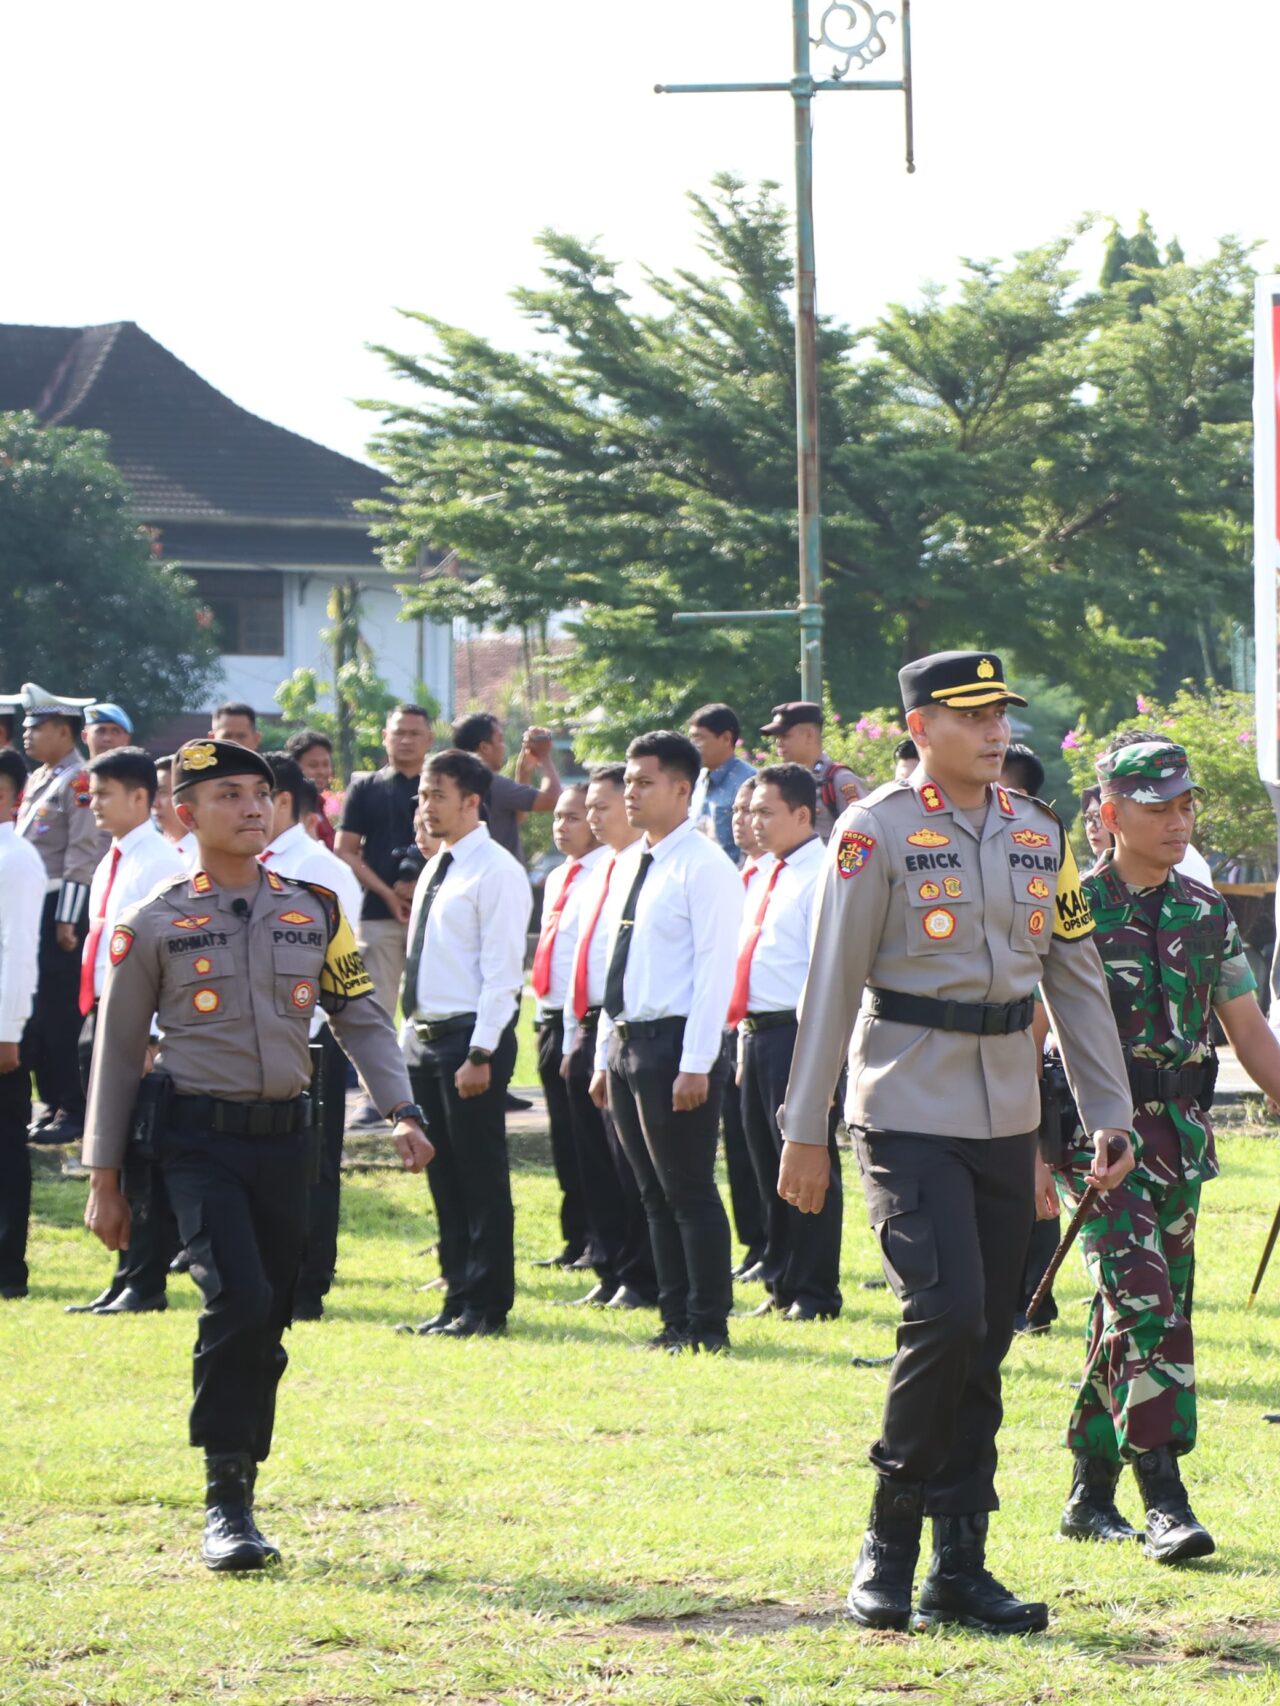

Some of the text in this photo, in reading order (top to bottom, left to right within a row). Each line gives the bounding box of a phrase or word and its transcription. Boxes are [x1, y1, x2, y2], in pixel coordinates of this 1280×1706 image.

[905, 853, 962, 872] ERICK
[1009, 853, 1058, 873] POLRI
[273, 930, 323, 947] POLRI
